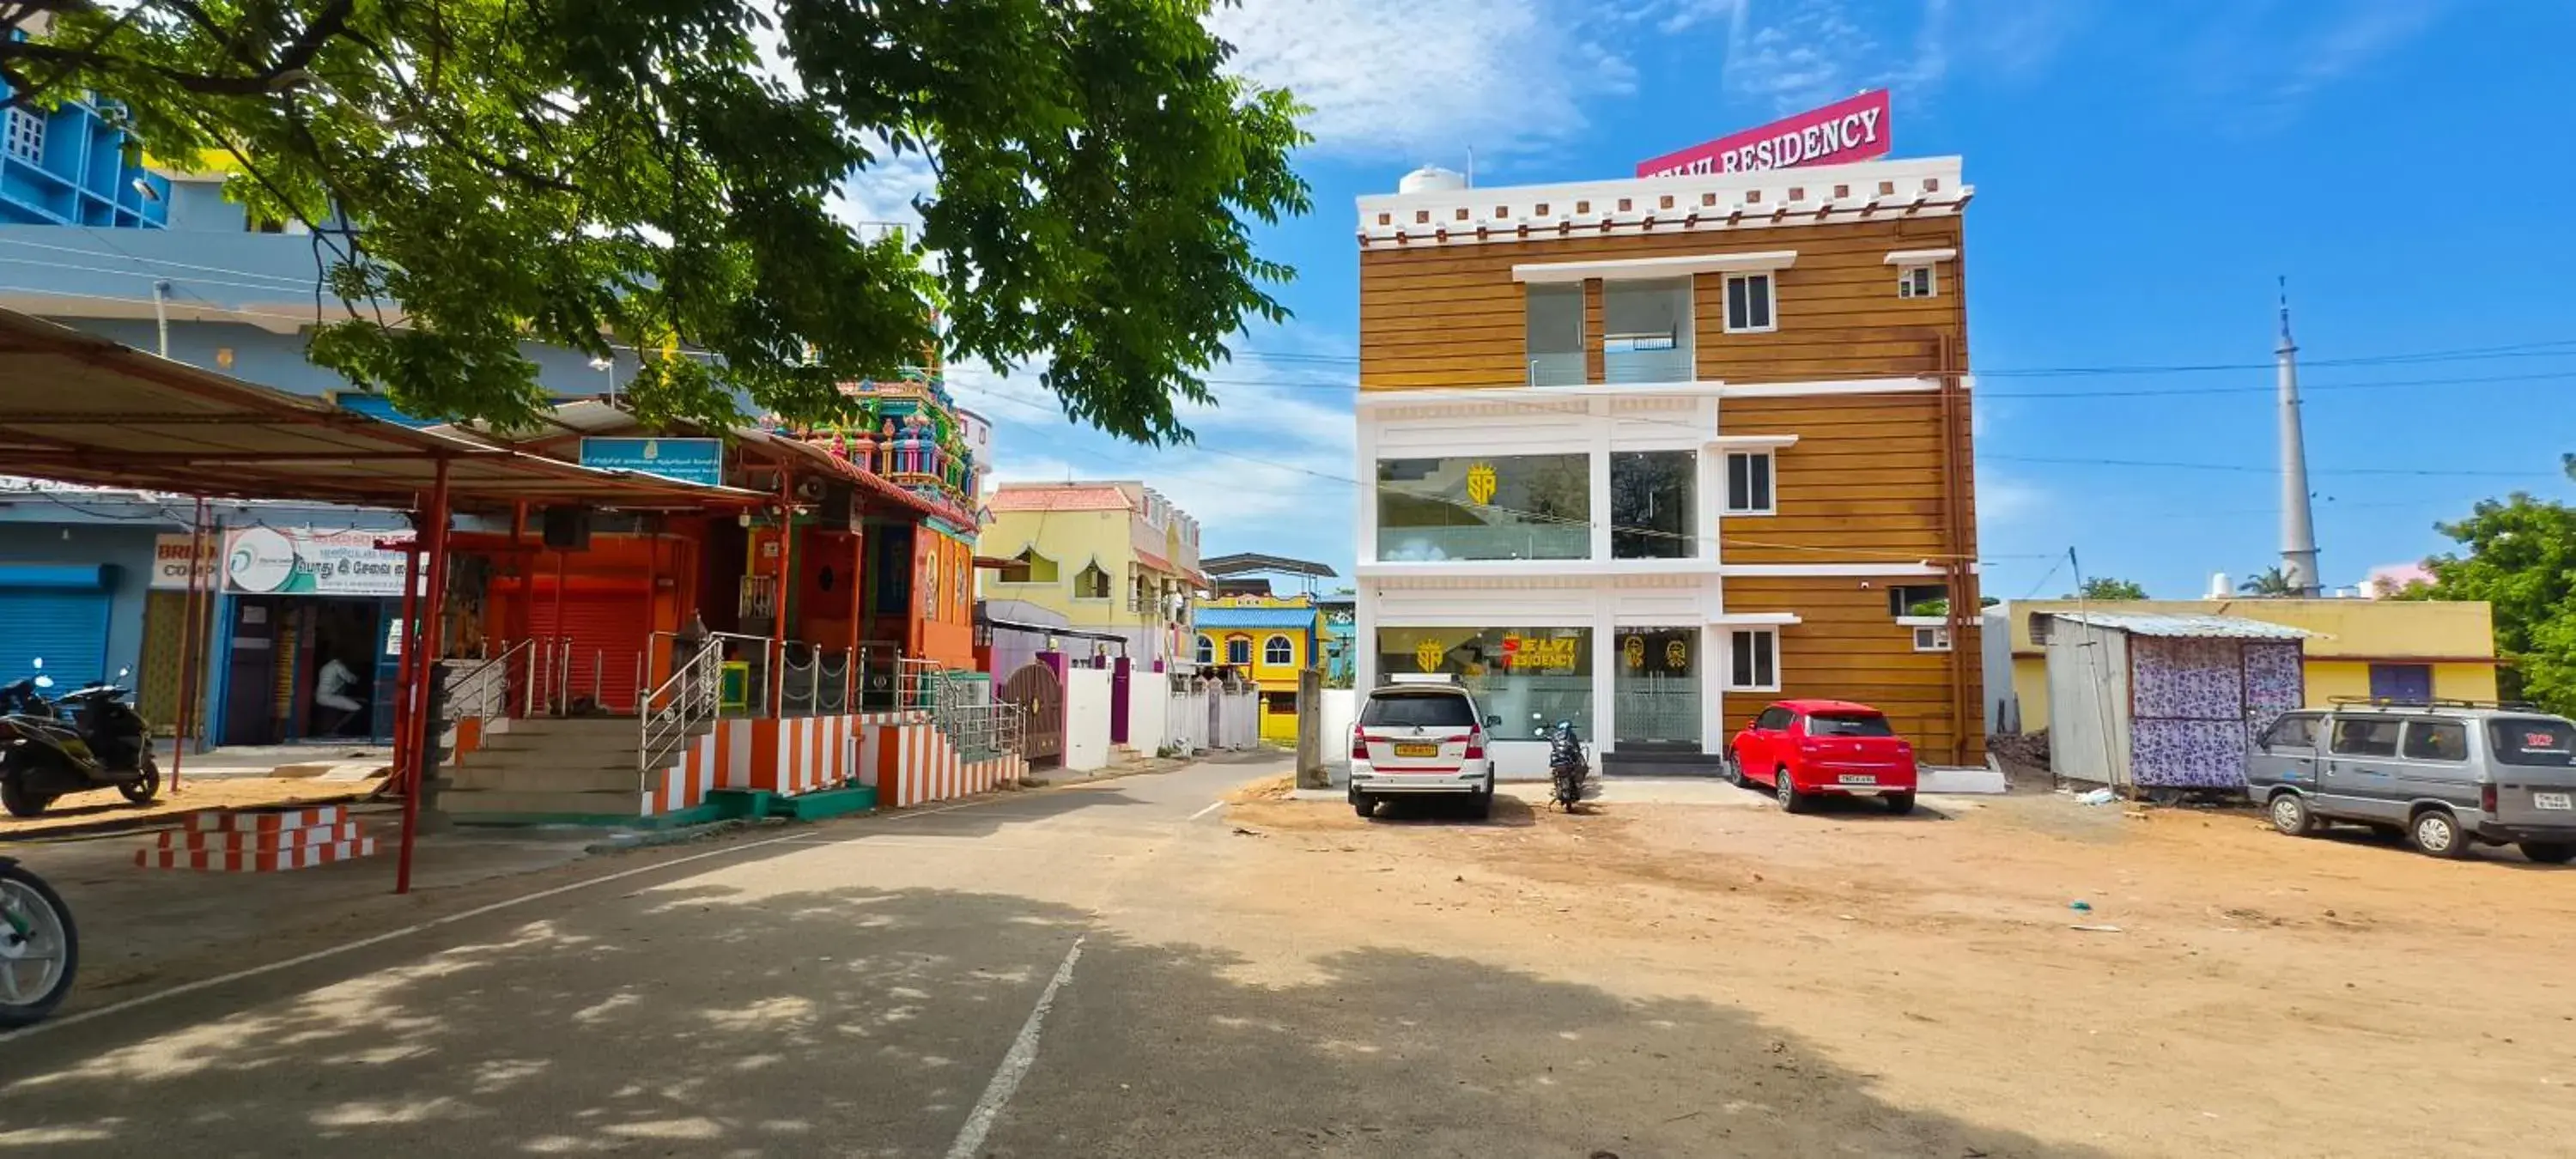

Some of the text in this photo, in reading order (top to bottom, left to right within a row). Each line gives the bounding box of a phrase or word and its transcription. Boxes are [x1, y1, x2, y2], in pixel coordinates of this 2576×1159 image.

[1721, 107, 1880, 173] RESIDENCY
[1503, 638, 1577, 652] SELVI
[1502, 652, 1576, 669] RESIDENCY
